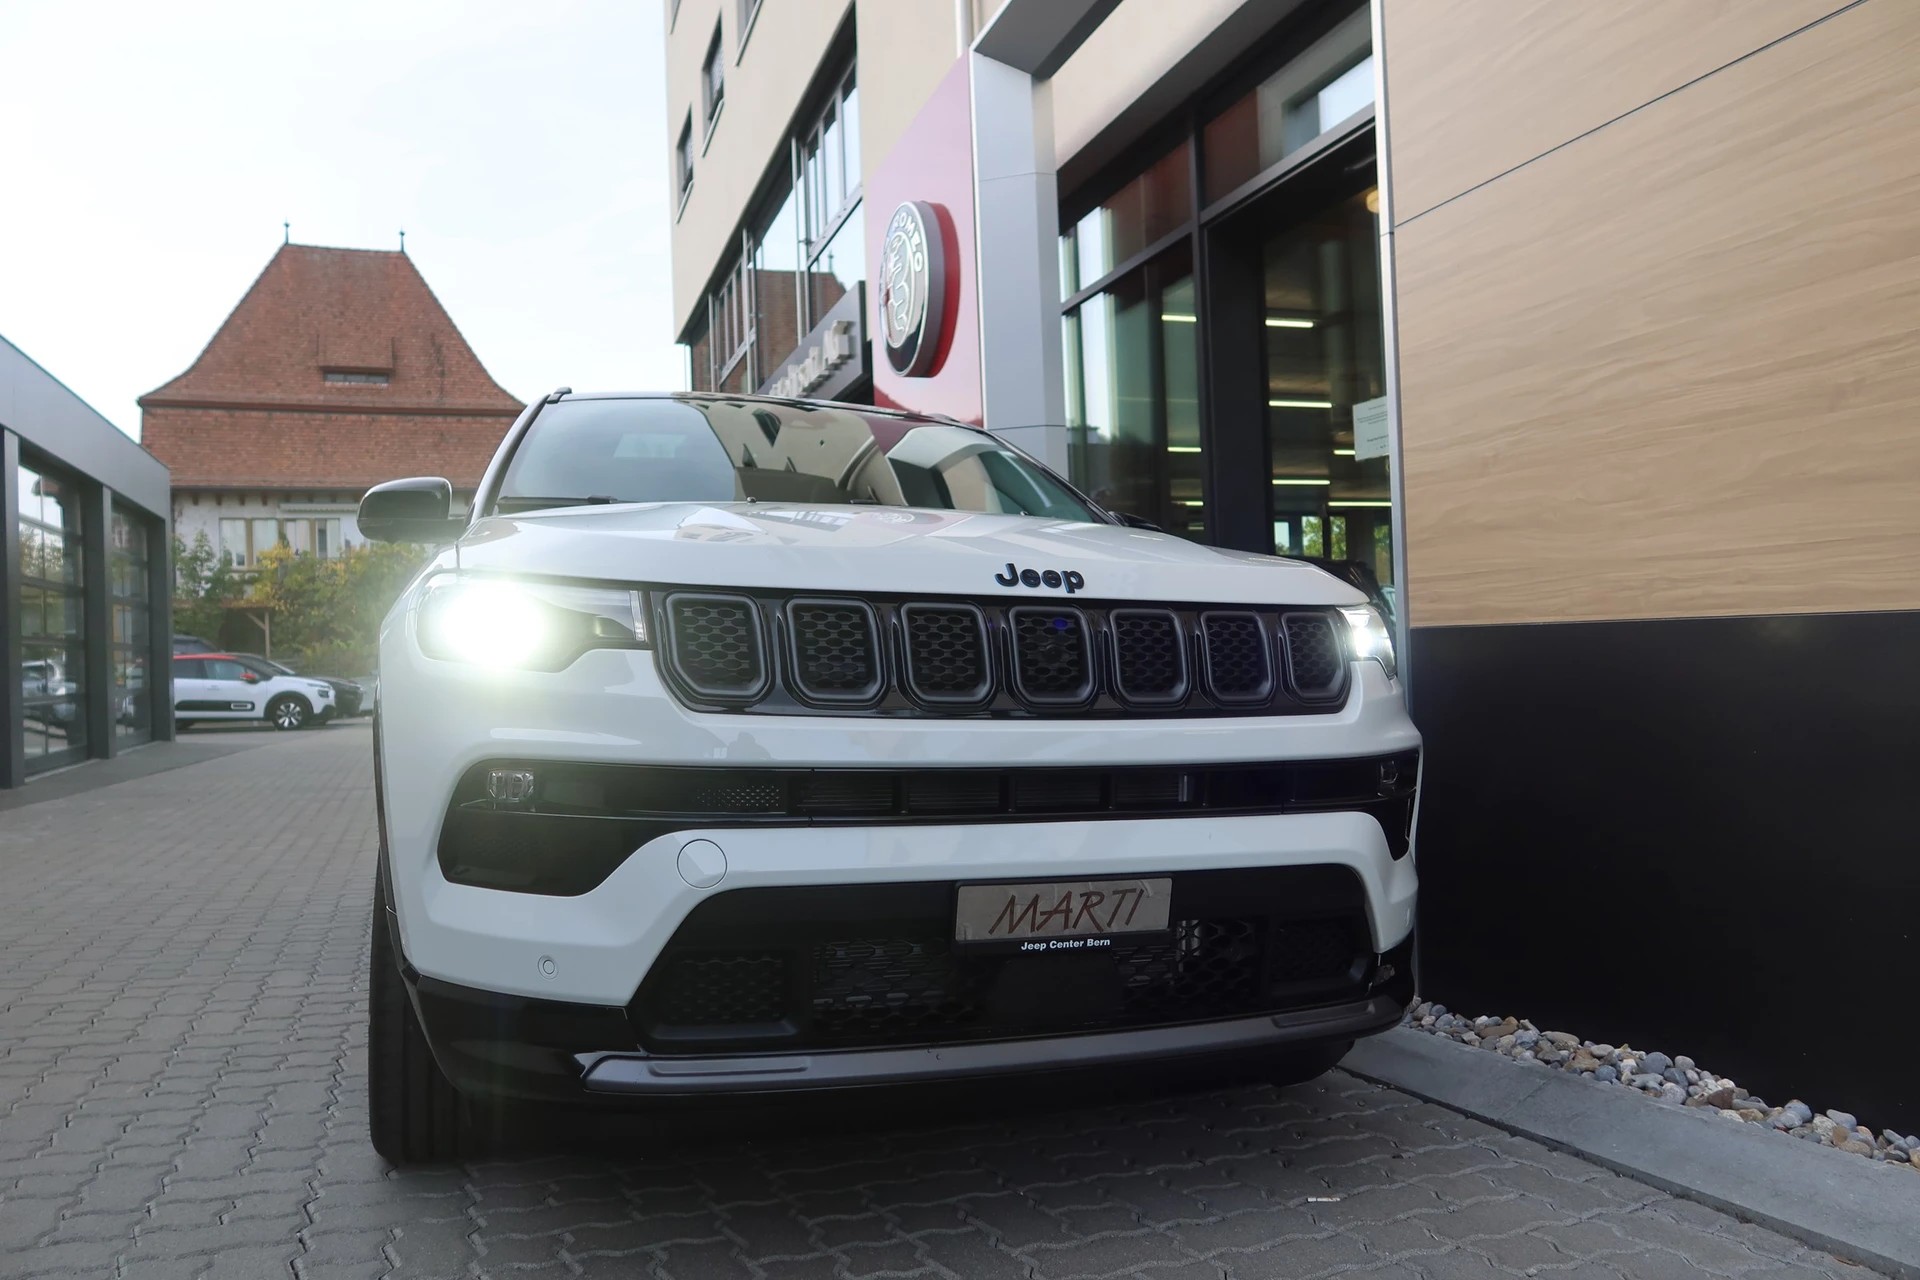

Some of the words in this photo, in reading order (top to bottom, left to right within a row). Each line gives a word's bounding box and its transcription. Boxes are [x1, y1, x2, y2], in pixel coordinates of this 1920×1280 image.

[893, 212, 923, 272] ROMEO
[994, 562, 1085, 594] Jeep
[988, 888, 1145, 935] MARTI
[1021, 942, 1047, 951] Jeep
[1049, 940, 1084, 950] Center
[1087, 938, 1111, 948] Bern
